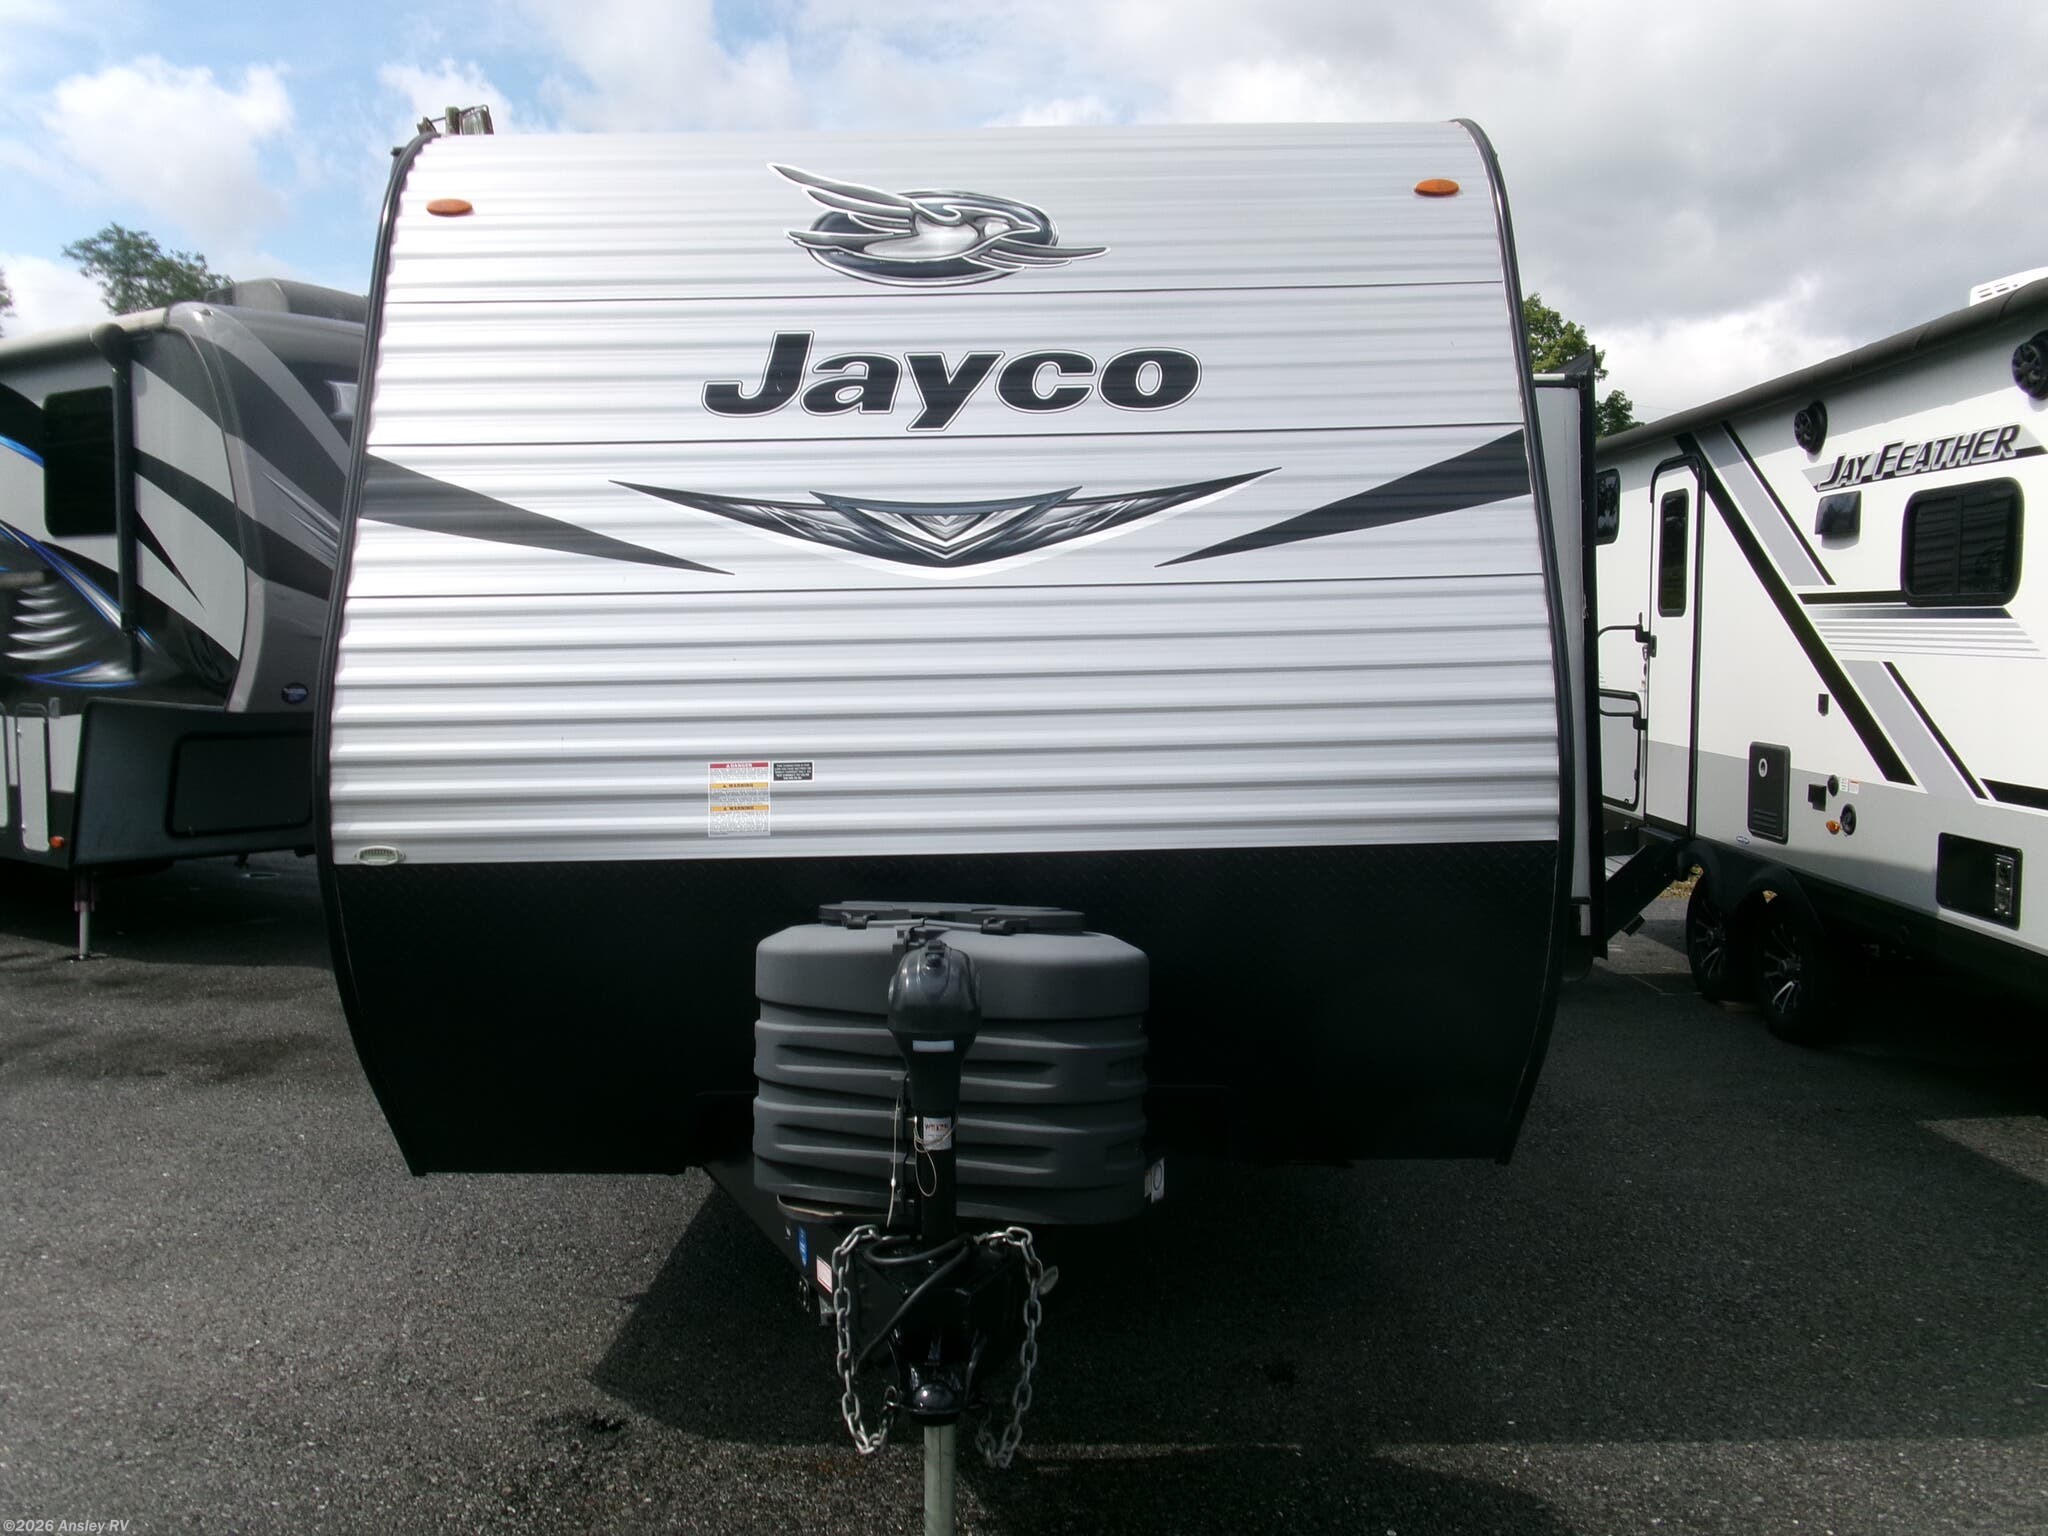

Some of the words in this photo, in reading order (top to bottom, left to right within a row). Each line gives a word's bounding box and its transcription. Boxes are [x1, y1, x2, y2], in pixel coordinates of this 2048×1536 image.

[702, 329, 1201, 432] Jayco
[1817, 453, 1872, 490] JAY
[1872, 423, 2021, 480] FEATHER
